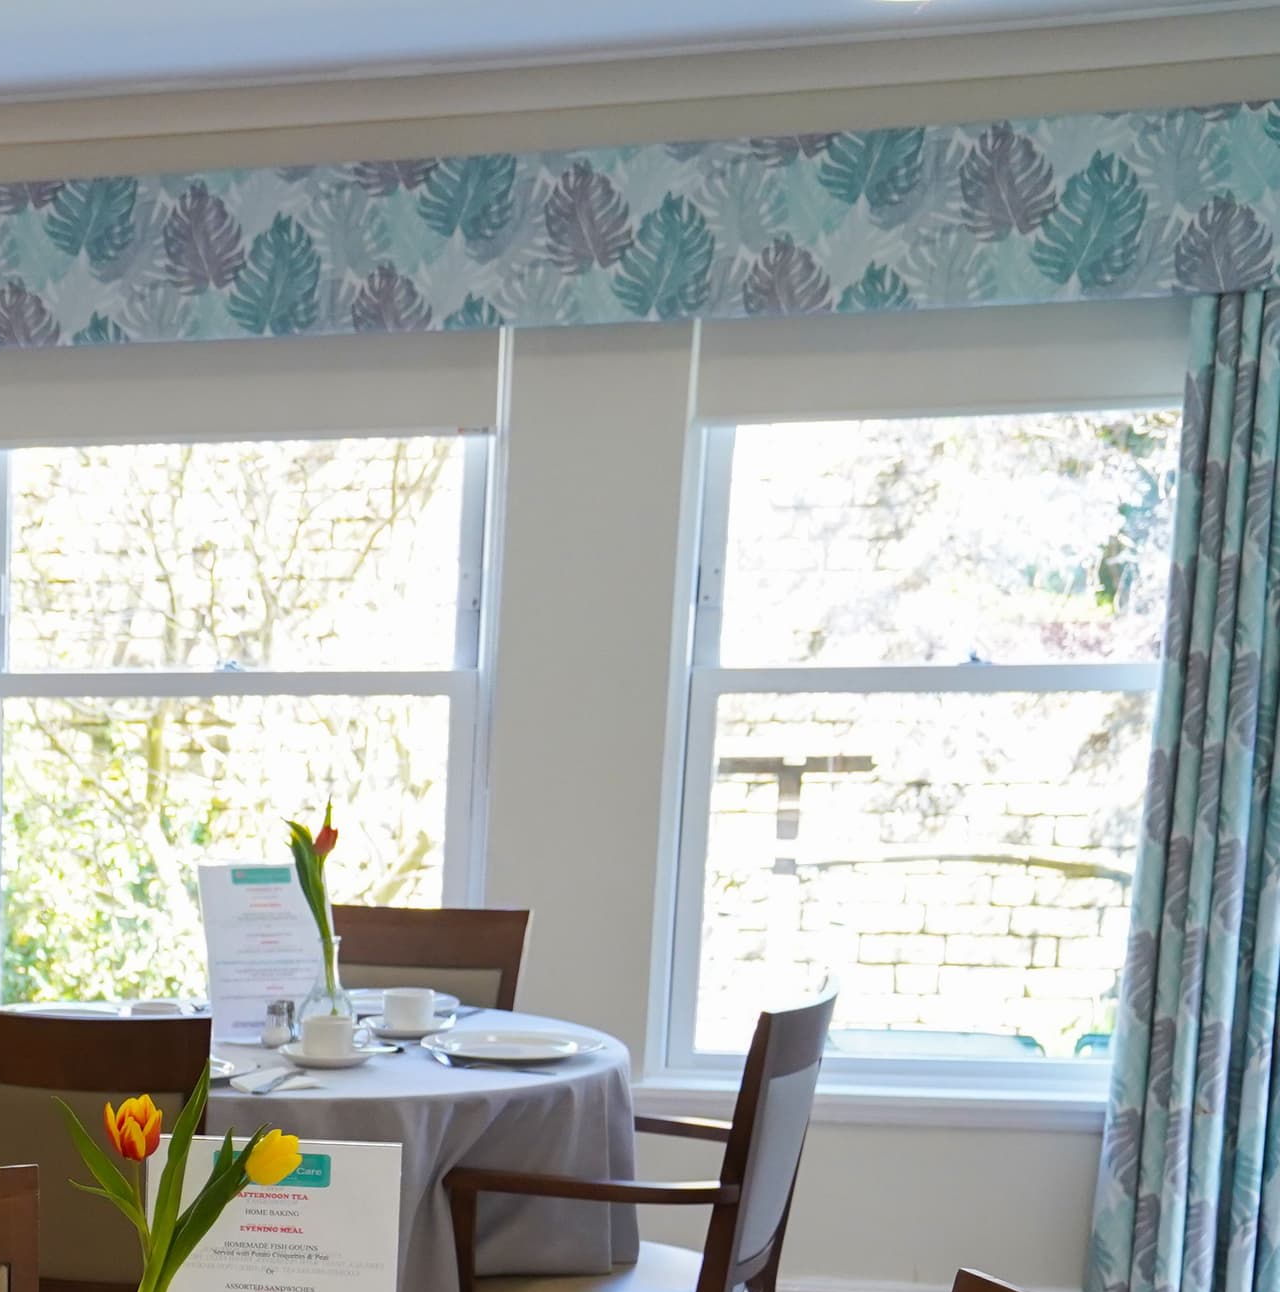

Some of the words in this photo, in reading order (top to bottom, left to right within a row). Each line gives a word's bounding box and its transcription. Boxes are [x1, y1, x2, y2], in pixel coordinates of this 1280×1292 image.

[296, 1167, 322, 1176] Care
[238, 1191, 289, 1200] AFTERNOON
[245, 1208, 268, 1217] HOME
[269, 1209, 299, 1217] BAKING
[240, 1225, 278, 1233] EVENING
[280, 1226, 304, 1234] MEAL
[224, 1241, 269, 1249] HOMEMADE
[270, 1243, 287, 1251] FISH
[212, 1248, 235, 1256] Served
[251, 1250, 271, 1258] Potato
[272, 1252, 305, 1260] Croquettes
[225, 1282, 263, 1292] ASSORTED
